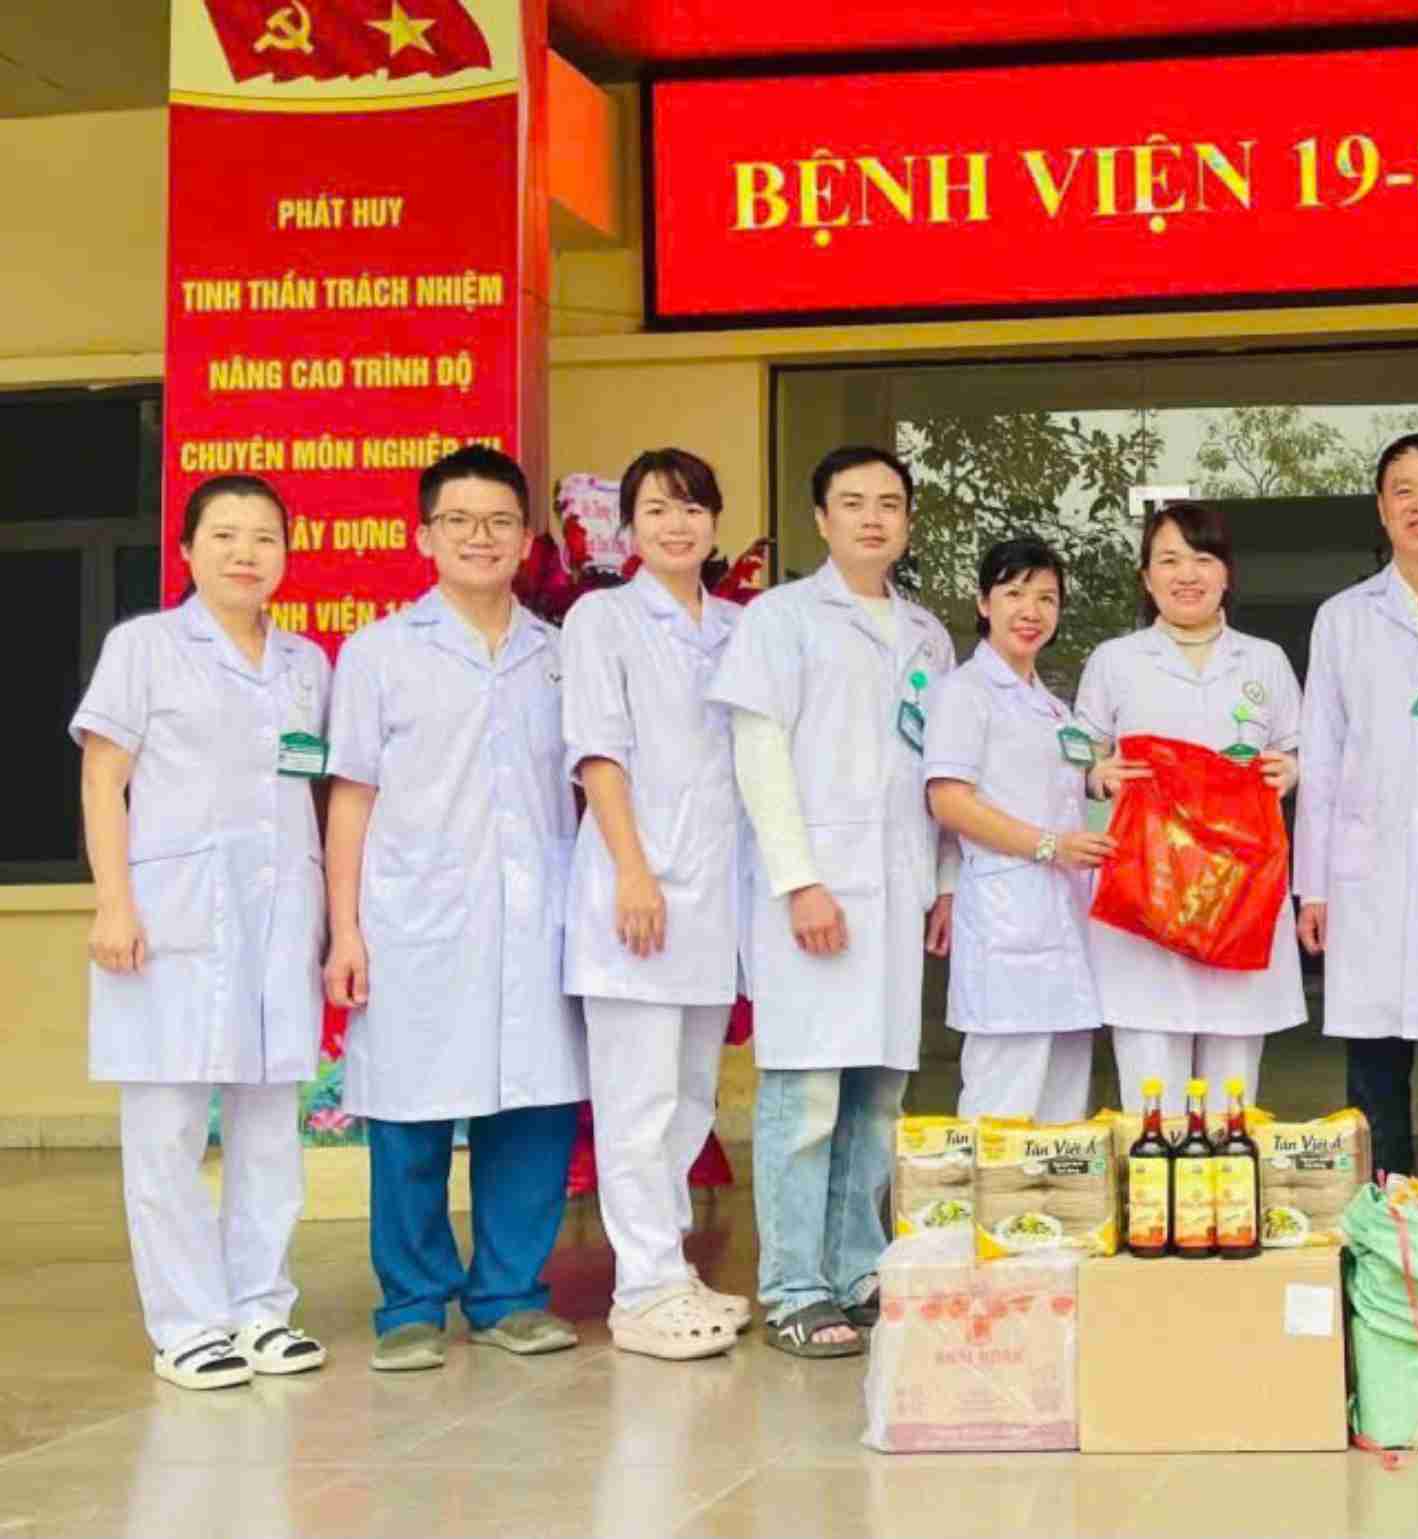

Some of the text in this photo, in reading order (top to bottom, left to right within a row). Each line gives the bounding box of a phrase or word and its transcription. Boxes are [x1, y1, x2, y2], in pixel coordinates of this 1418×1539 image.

[278, 193, 403, 229] PHÁT HUY
[728, 147, 993, 249] BỆNH
[1023, 132, 1256, 235] VIỆN
[182, 280, 241, 311] TINH
[324, 272, 409, 308] TRÁCH
[416, 269, 503, 311] NHIỆM
[209, 353, 283, 391] NÂNG
[291, 359, 345, 388] CAO
[436, 349, 474, 392] ĐỘ
[180, 434, 285, 472] CHUYÊN
[292, 432, 355, 470] MÔN
[289, 513, 407, 557] ÂY DỰNG
